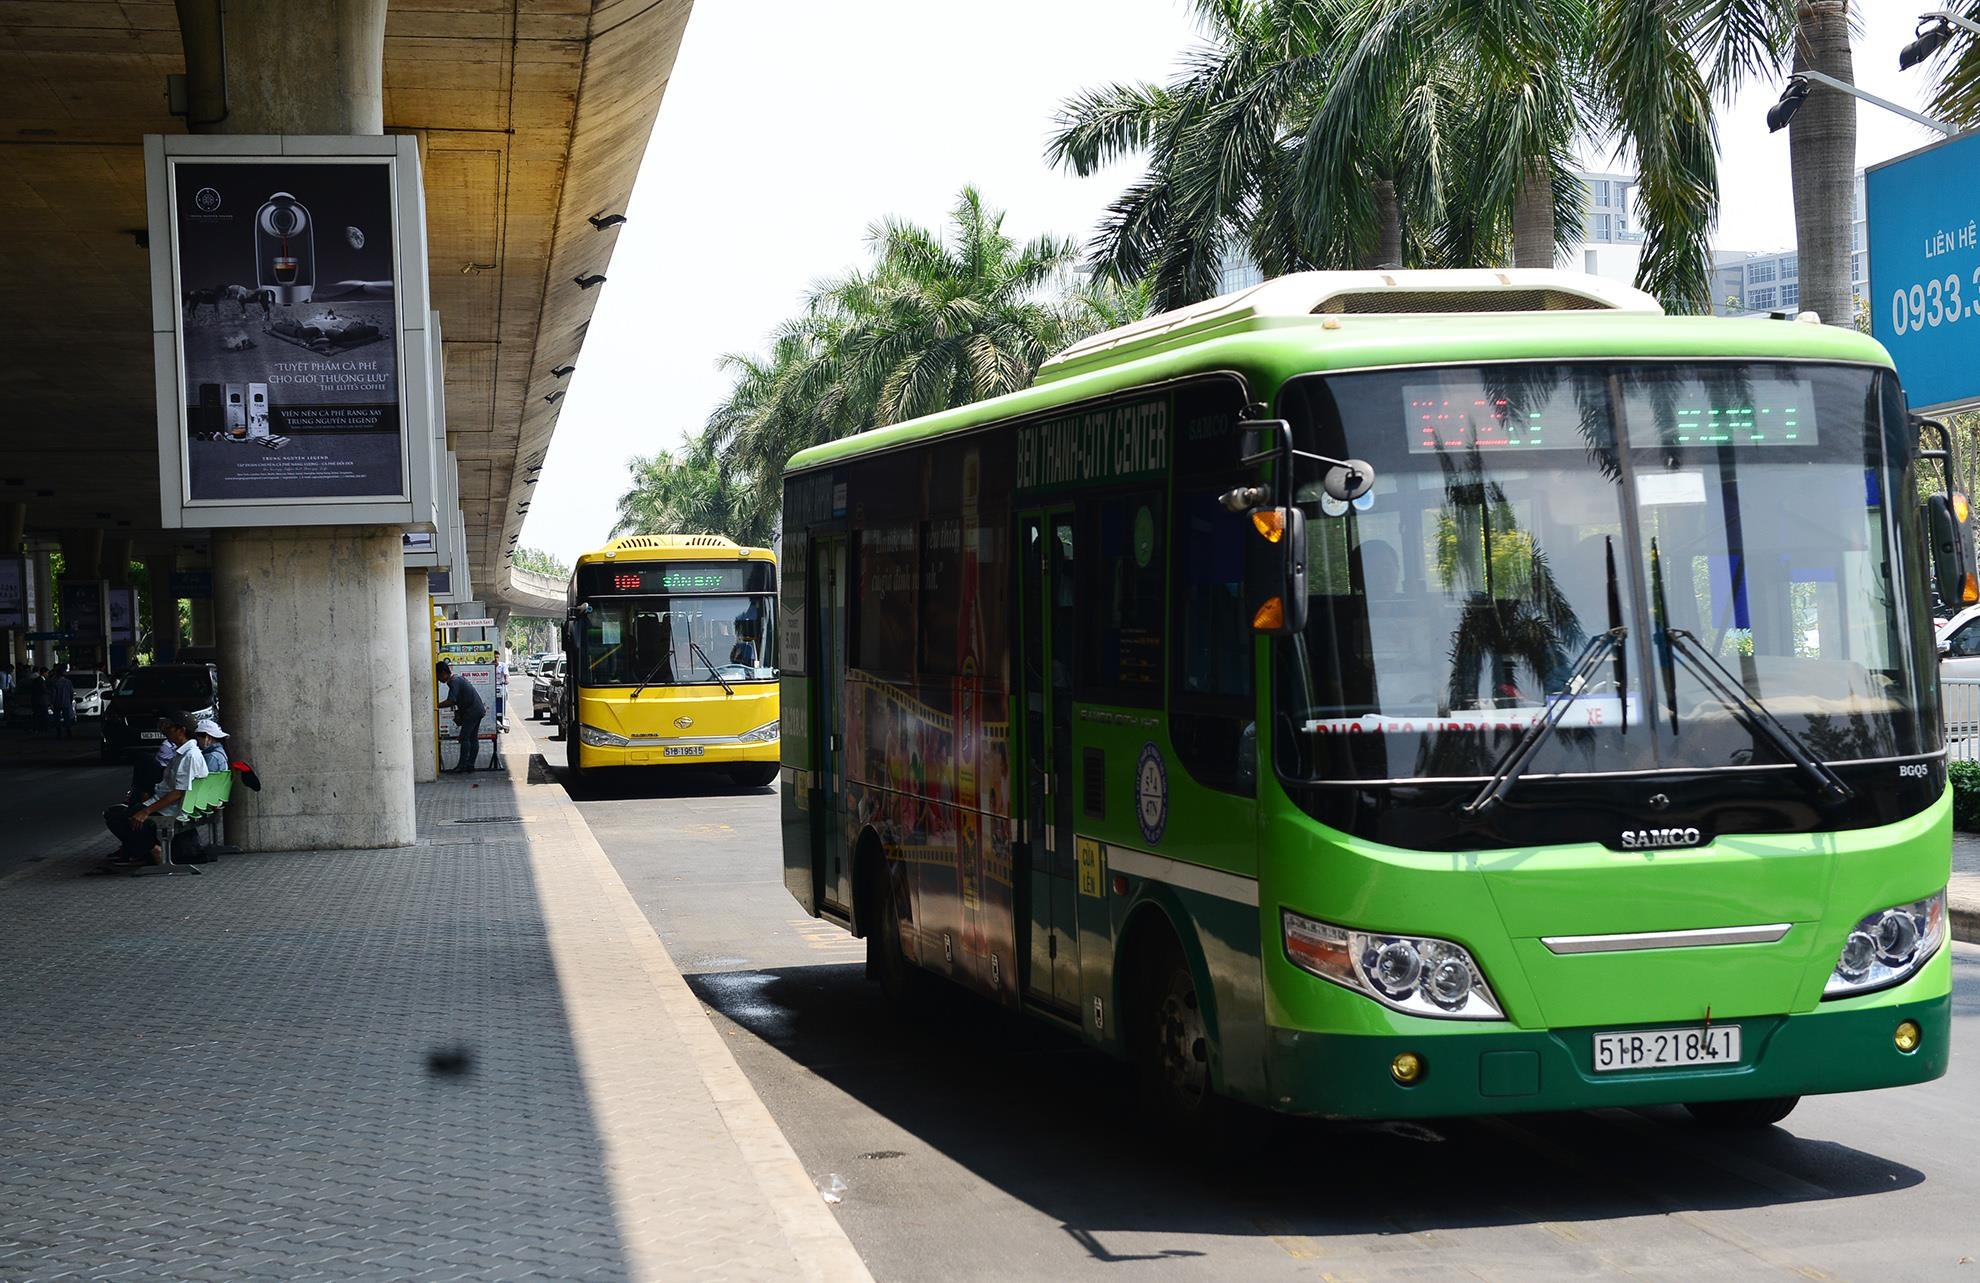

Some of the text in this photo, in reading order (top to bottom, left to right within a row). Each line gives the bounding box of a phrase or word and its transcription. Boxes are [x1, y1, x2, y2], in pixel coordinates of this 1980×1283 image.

[1925, 220, 1977, 258] LIÊN HỆ
[1016, 401, 1167, 489] BEN THANH-CITY CENTER
[1621, 827, 1701, 848] SAMCO
